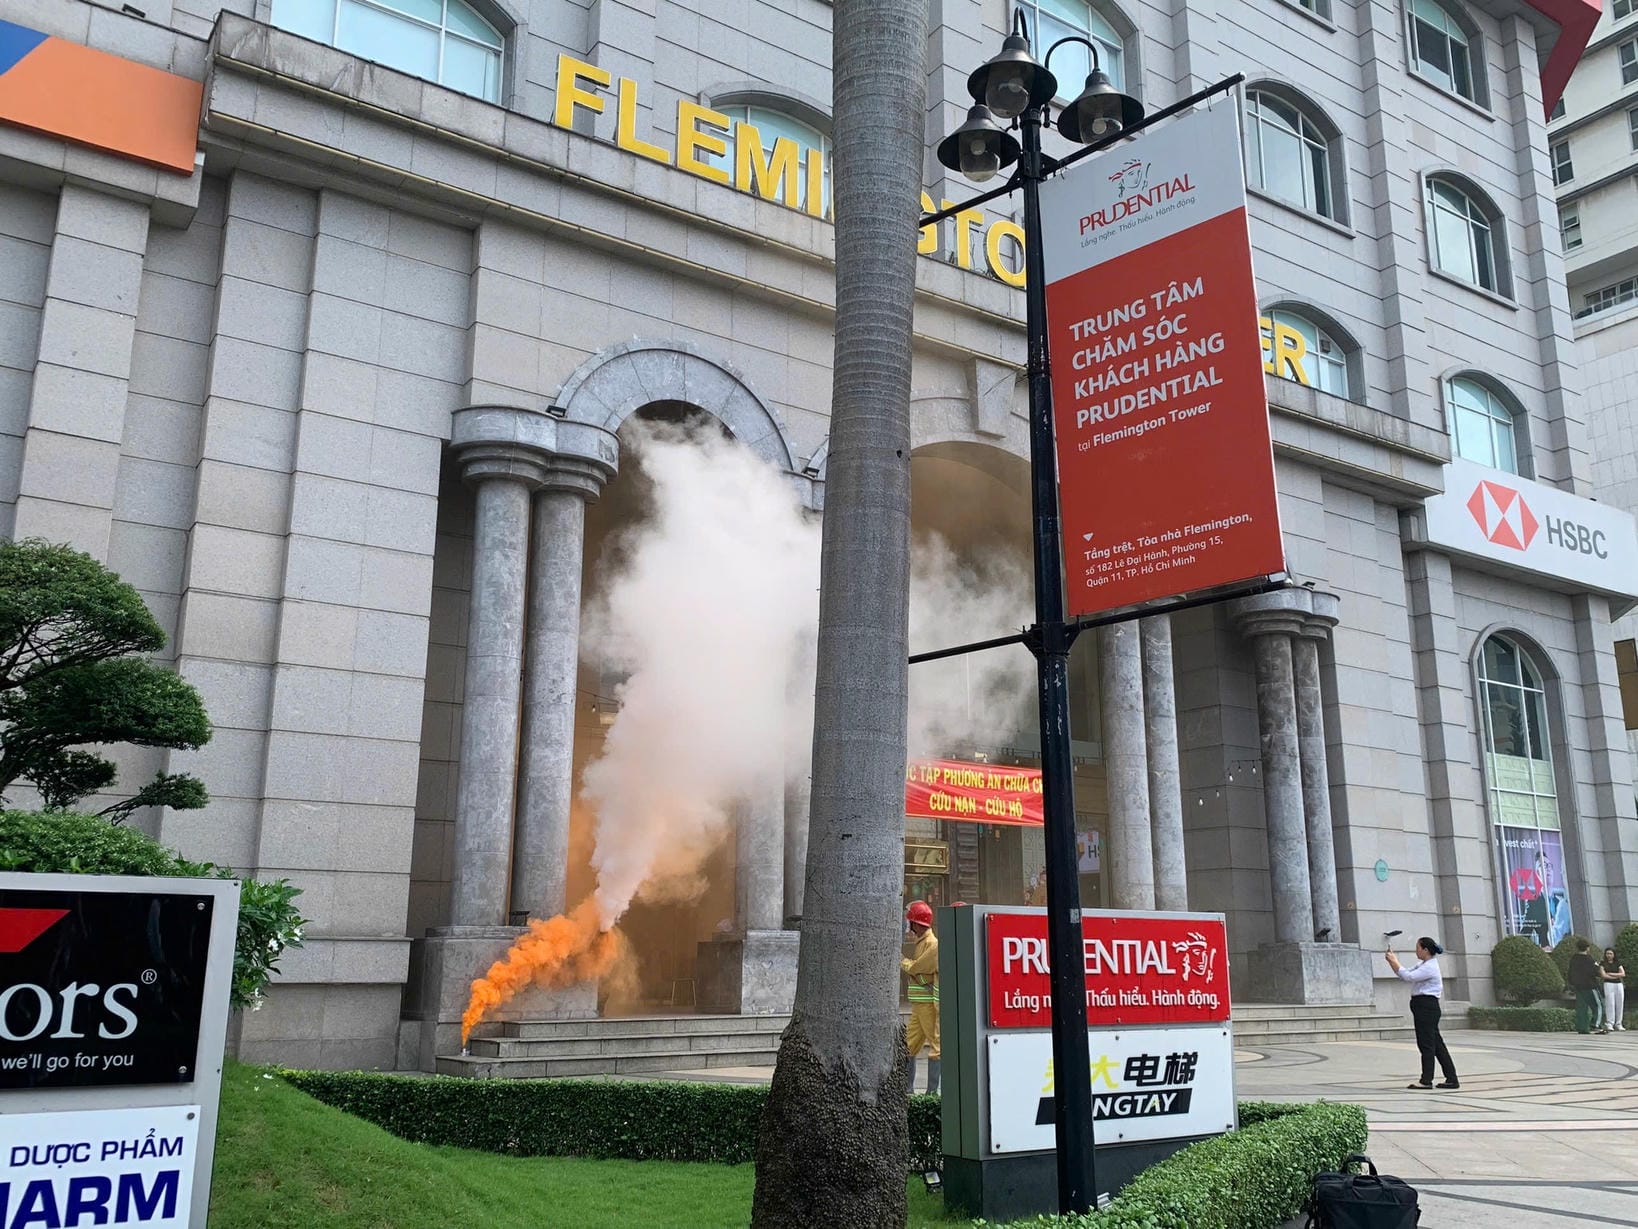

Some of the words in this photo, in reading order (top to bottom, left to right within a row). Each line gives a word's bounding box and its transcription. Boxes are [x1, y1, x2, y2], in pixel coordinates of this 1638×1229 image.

[1080, 173, 1195, 236] PRUDENTIAL
[1069, 299, 1147, 342] TRUNG
[1151, 277, 1204, 311] TÂM
[1072, 332, 1136, 370] CHĂM
[1142, 313, 1188, 346] SÓC
[1074, 358, 1149, 400] KHÁCH
[1156, 332, 1225, 372] HÀNG
[1077, 366, 1223, 429] PRUDENTIAL
[1078, 440, 1091, 453] tại
[1093, 411, 1166, 447] Flemington
[1169, 401, 1212, 424] Tower
[1084, 547, 1111, 561] Tầng
[1113, 541, 1135, 554] trệt,
[1137, 535, 1158, 548] Tòa
[1161, 530, 1182, 542] nhà
[1184, 513, 1253, 537] Flemington,
[1085, 565, 1095, 576] số
[1097, 563, 1113, 573] 182
[1115, 560, 1125, 569] Lê
[1126, 555, 1142, 566] Đại
[1144, 549, 1170, 561] Hành,
[1172, 541, 1207, 555] Phường
[1209, 536, 1224, 546] 15,
[1546, 515, 1608, 560] HSBC
[1086, 576, 1109, 588] Quận
[1111, 572, 1124, 582] 11,
[1126, 568, 1139, 579] TP.
[1141, 563, 1153, 575] Hồ
[1155, 560, 1170, 571] Chí
[1172, 554, 1196, 569] Minh
[920, 764, 940, 786] TẬP
[944, 767, 985, 789] PHƯƠNG
[987, 768, 1001, 789] ÁN
[1004, 773, 1030, 793] CHỮA
[929, 790, 952, 812] CỨU
[954, 797, 977, 816] NẠN
[985, 795, 1006, 817] CỨU
[1009, 798, 1023, 819] HỘ
[1003, 937, 1177, 975] PRUENTIAL
[1004, 987, 1040, 1012] Lắng
[1086, 987, 1116, 1007] Thấu
[1119, 986, 1149, 1006] hiểu.
[1152, 989, 1185, 1006] Hành
[1187, 989, 1220, 1010] động.
[47, 1056, 69, 1072] go
[75, 1053, 99, 1068] for
[102, 1054, 134, 1071] you
[1093, 1092, 1177, 1118] NGTAY
[9, 1142, 91, 1169] DƯỢC
[100, 1128, 184, 1162] PHẨM
